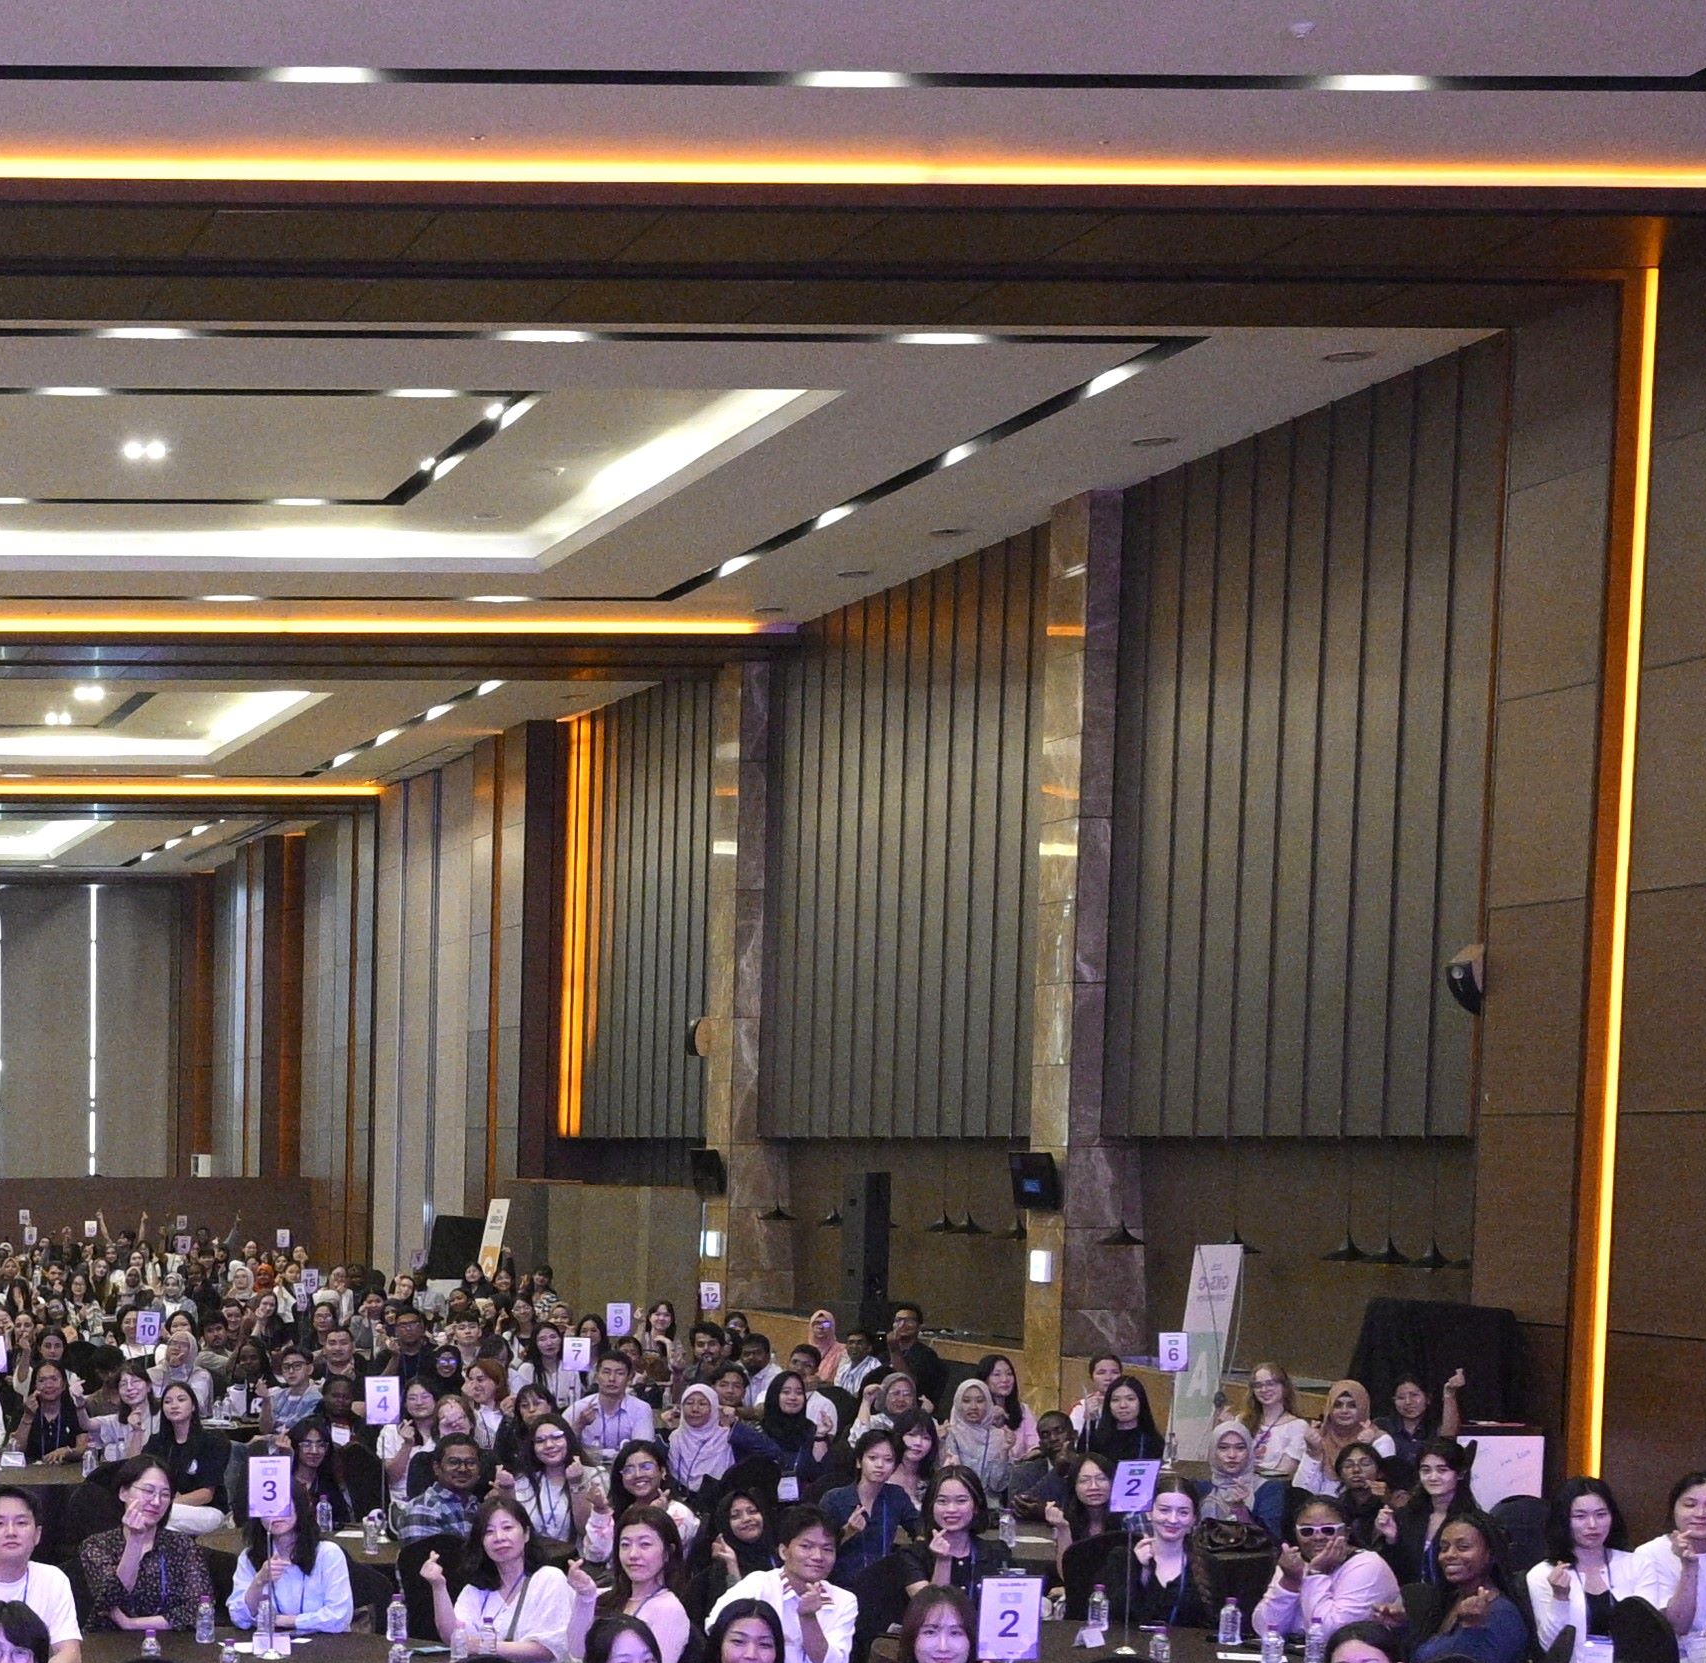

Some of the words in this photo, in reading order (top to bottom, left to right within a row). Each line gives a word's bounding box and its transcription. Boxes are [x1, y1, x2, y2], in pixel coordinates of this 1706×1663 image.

[304, 1278, 316, 1287] 15
[705, 1293, 718, 1303] 12
[614, 1316, 623, 1328] 9
[141, 1325, 155, 1336] 10
[572, 1350, 581, 1361] 7
[1169, 1348, 1178, 1361] 6
[377, 1396, 389, 1411] 4
[263, 1481, 276, 1501] 3
[1125, 1479, 1141, 1496] 2
[998, 1610, 1019, 1637] 2
